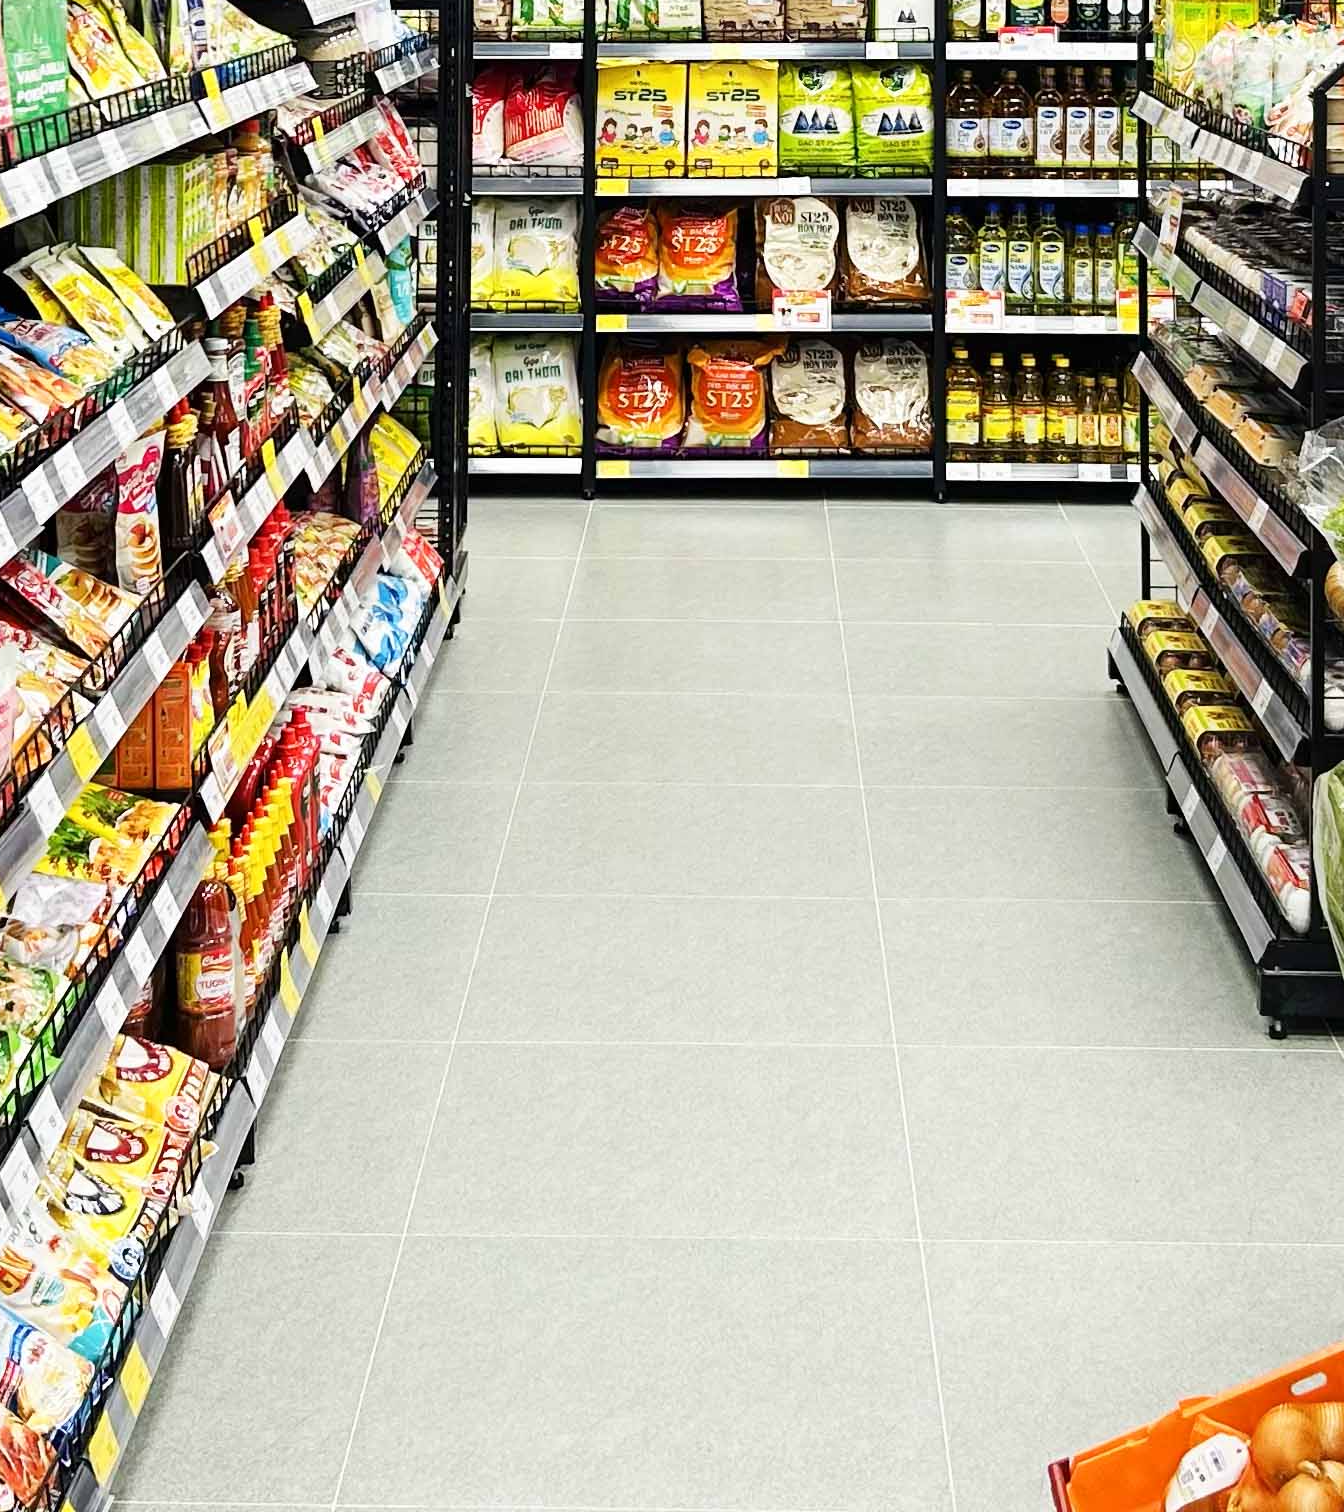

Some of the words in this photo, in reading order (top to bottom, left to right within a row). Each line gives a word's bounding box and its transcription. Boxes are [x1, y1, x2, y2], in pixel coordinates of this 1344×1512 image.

[614, 88, 668, 102] ST25
[706, 88, 761, 102] ST25
[706, 390, 753, 408] ST25
